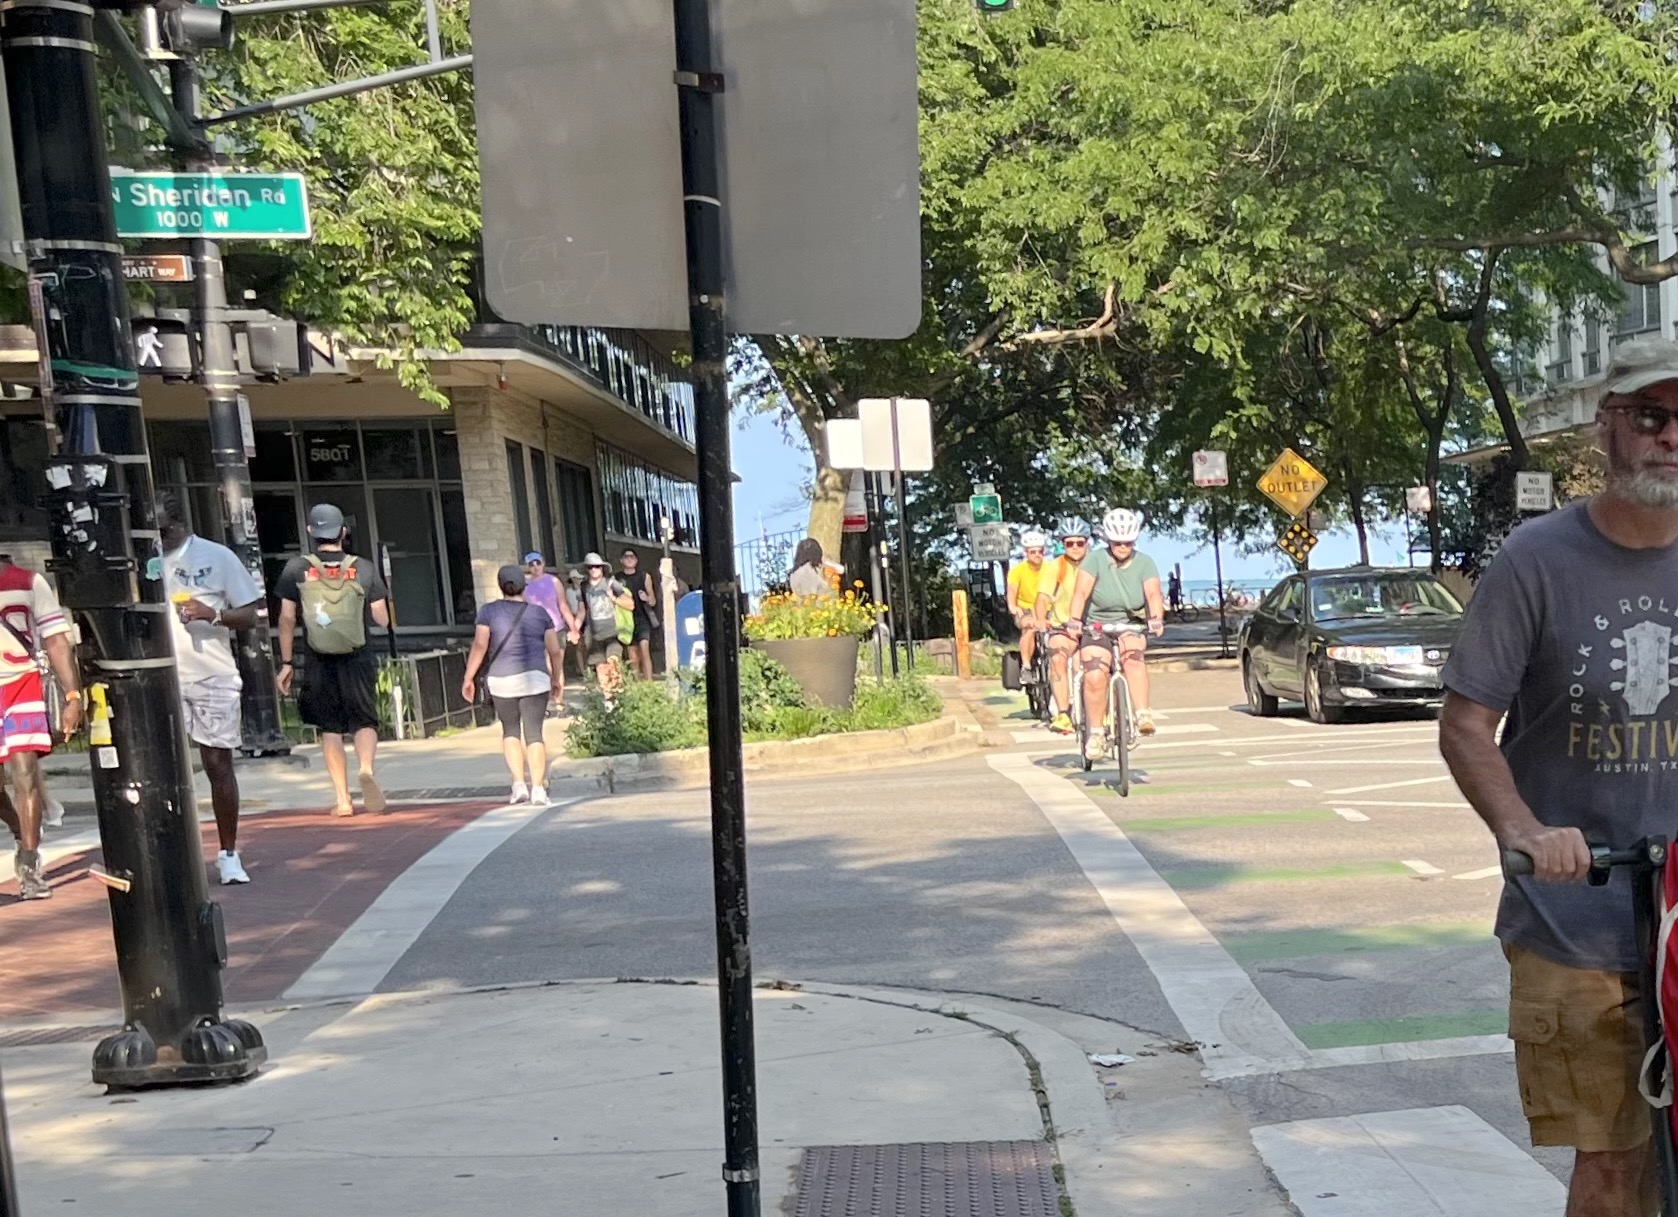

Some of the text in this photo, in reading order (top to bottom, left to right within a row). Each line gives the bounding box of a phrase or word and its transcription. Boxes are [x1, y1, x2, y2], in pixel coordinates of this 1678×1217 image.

[130, 183, 252, 208] Sheridan
[261, 188, 286, 205] Rd
[156, 211, 230, 228] 1000 W
[157, 268, 177, 277] WAY
[1280, 464, 1301, 477] NO
[1267, 480, 1317, 494] OUTLET
[1528, 477, 1540, 486] NO
[982, 529, 995, 537] NO
[1569, 642, 1593, 716] ROCK
[1593, 613, 1610, 631] &
[1660, 761, 1678, 771] TX
